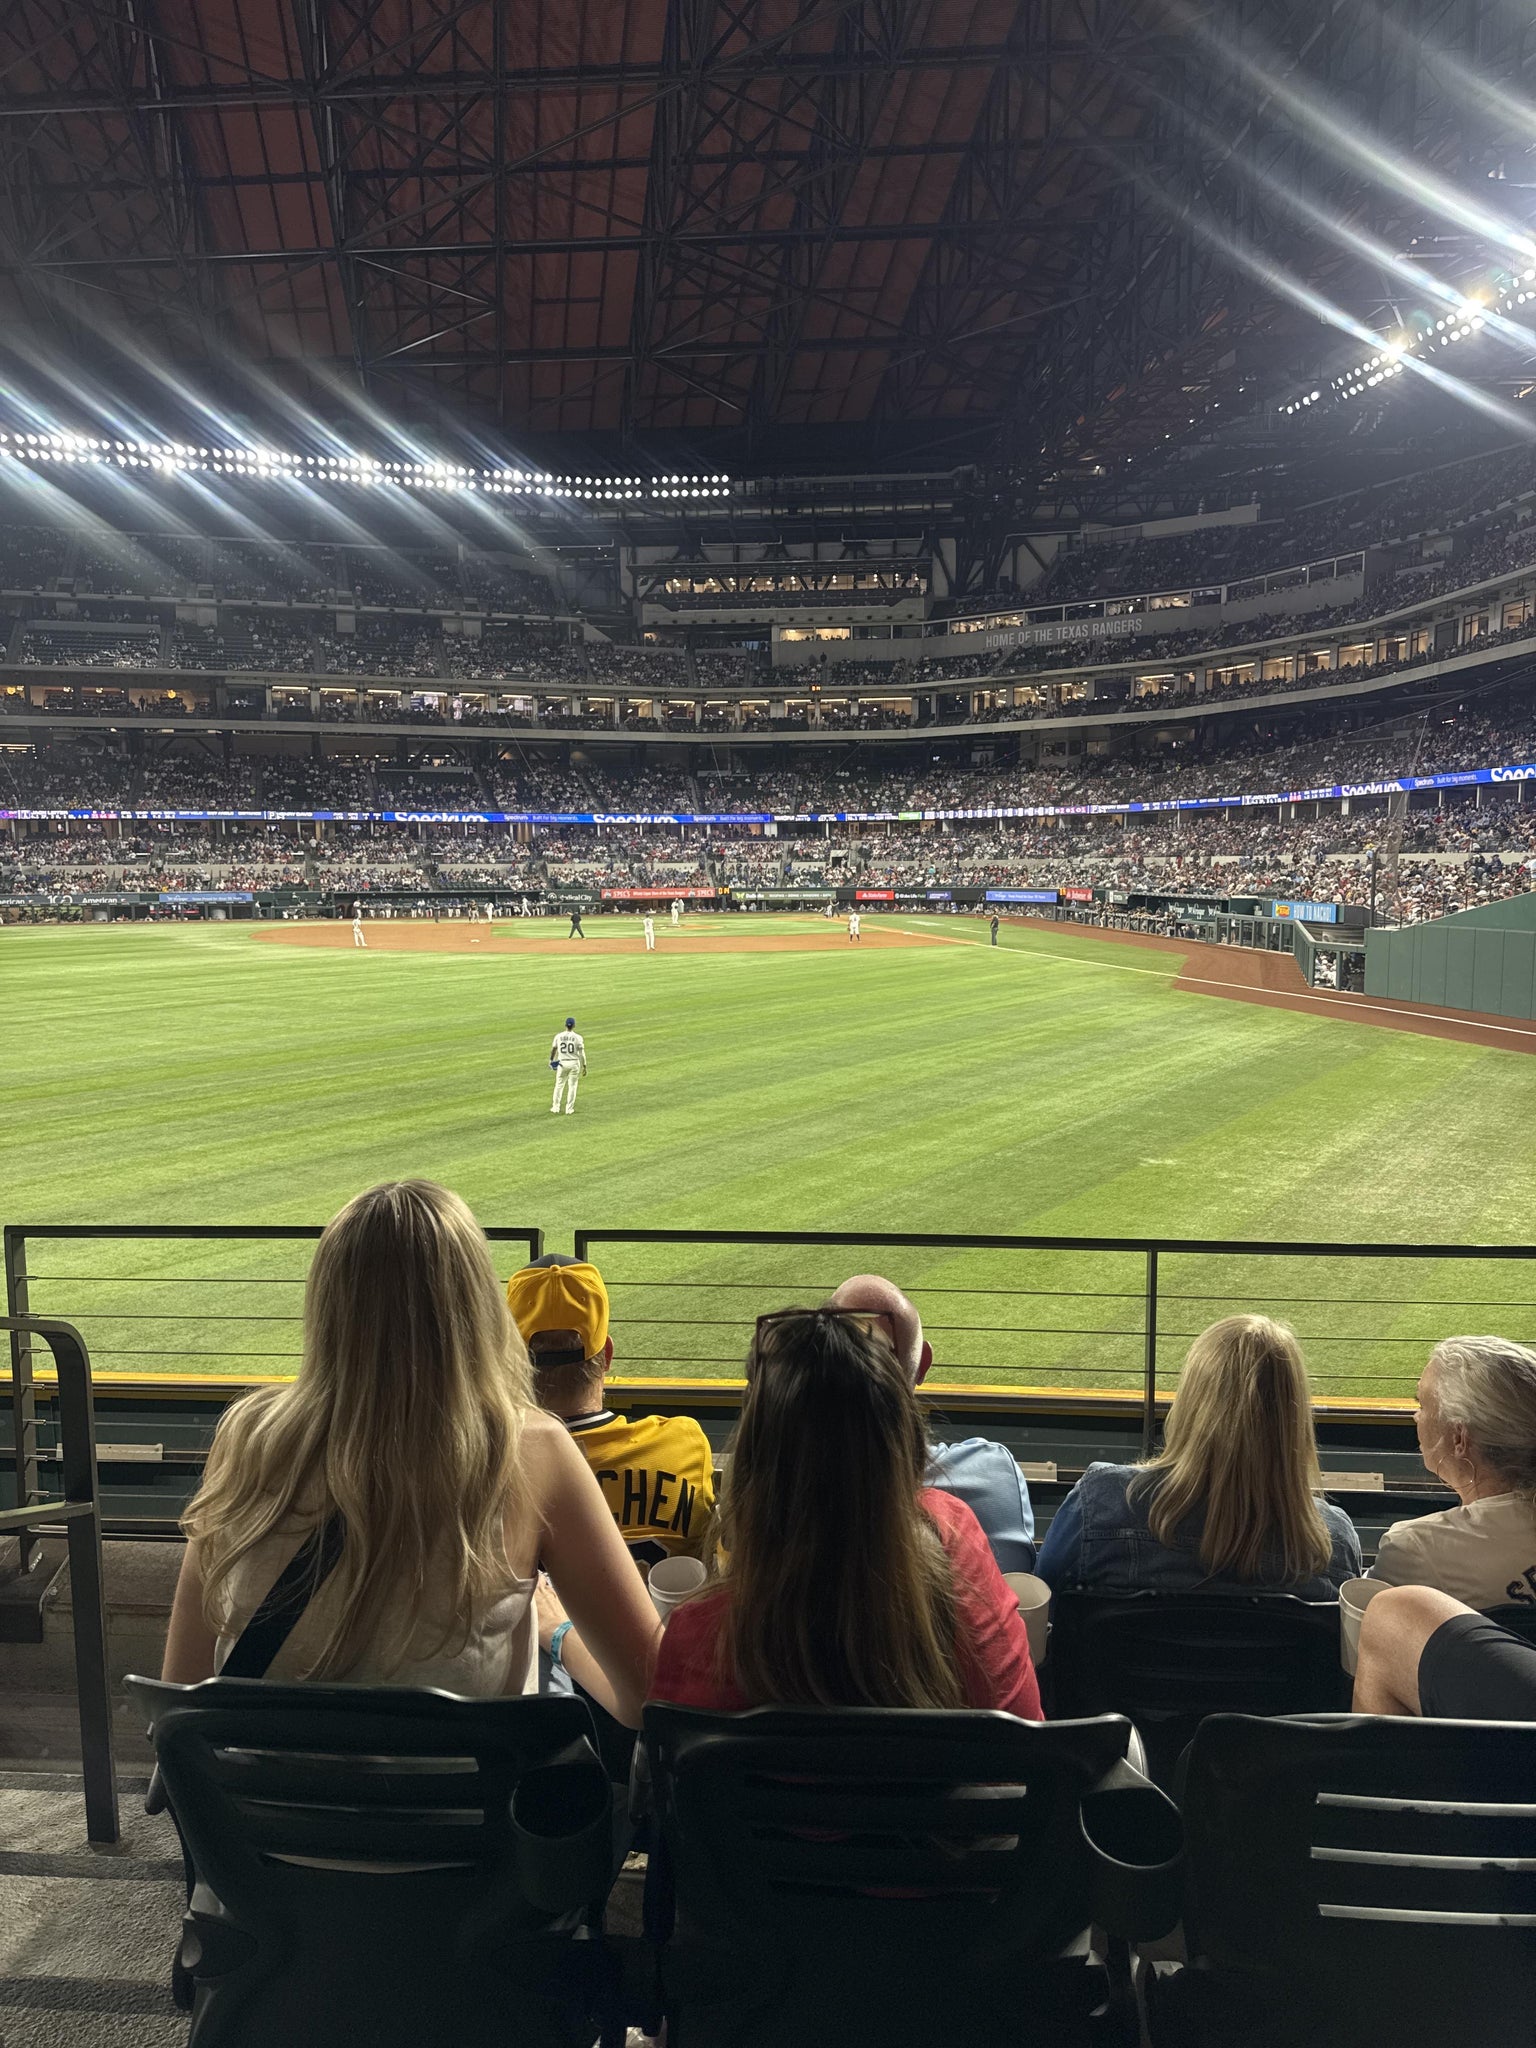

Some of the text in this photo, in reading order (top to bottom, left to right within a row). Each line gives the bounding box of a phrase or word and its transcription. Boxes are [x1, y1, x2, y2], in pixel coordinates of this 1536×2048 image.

[986, 618, 1143, 648] HOME OF THE TEXAS RANGERS
[395, 812, 485, 822] Spectrum
[593, 814, 676, 823] Spectrum
[1294, 904, 1305, 919] HOW
[1306, 904, 1312, 920] TO
[560, 1042, 575, 1054] 20
